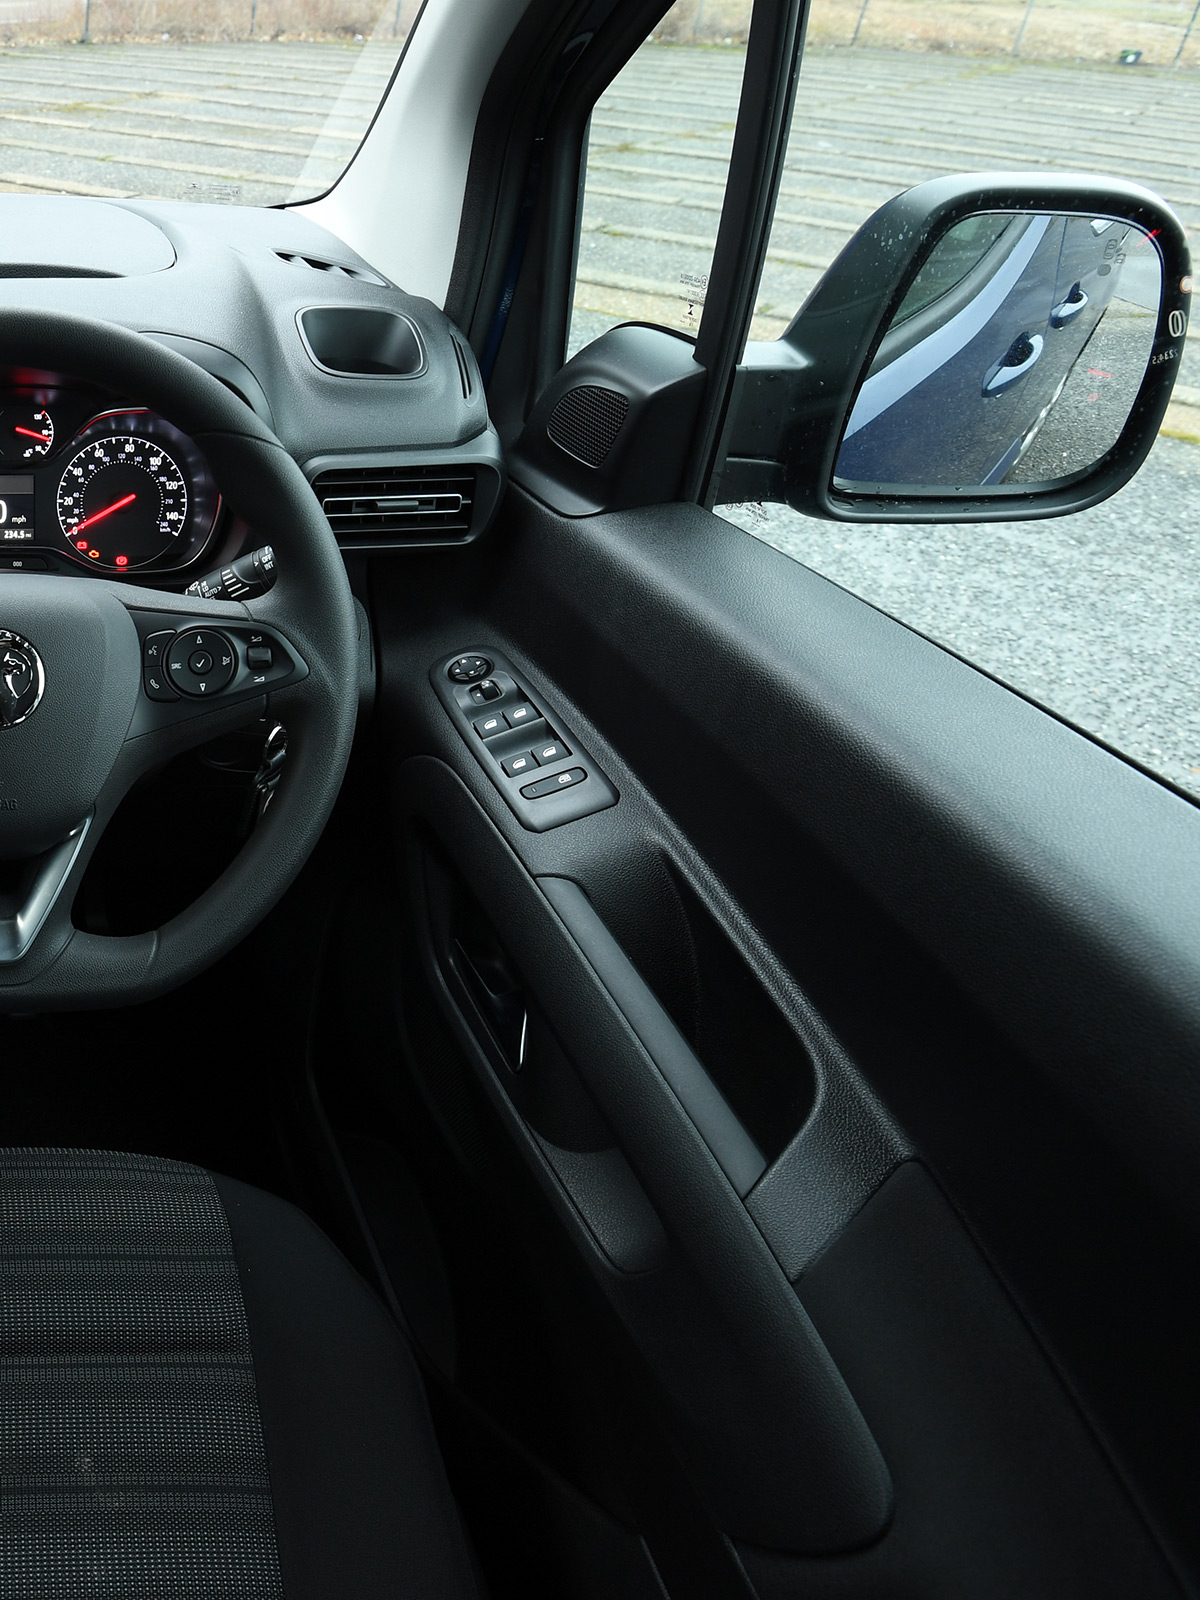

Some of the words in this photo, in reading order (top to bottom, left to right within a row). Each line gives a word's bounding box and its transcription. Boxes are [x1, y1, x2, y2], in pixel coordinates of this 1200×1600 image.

[94, 448, 104, 458] 60
[124, 443, 135, 453] 80
[149, 457, 162, 466] 100
[72, 467, 83, 477] 40
[165, 480, 178, 490] 120
[63, 496, 73, 506] 20
[11, 515, 27, 524] mph
[166, 511, 179, 521] 140
[3, 530, 25, 539] 234.5
[72, 526, 78, 536] 0
[261, 555, 272, 563] OFF
